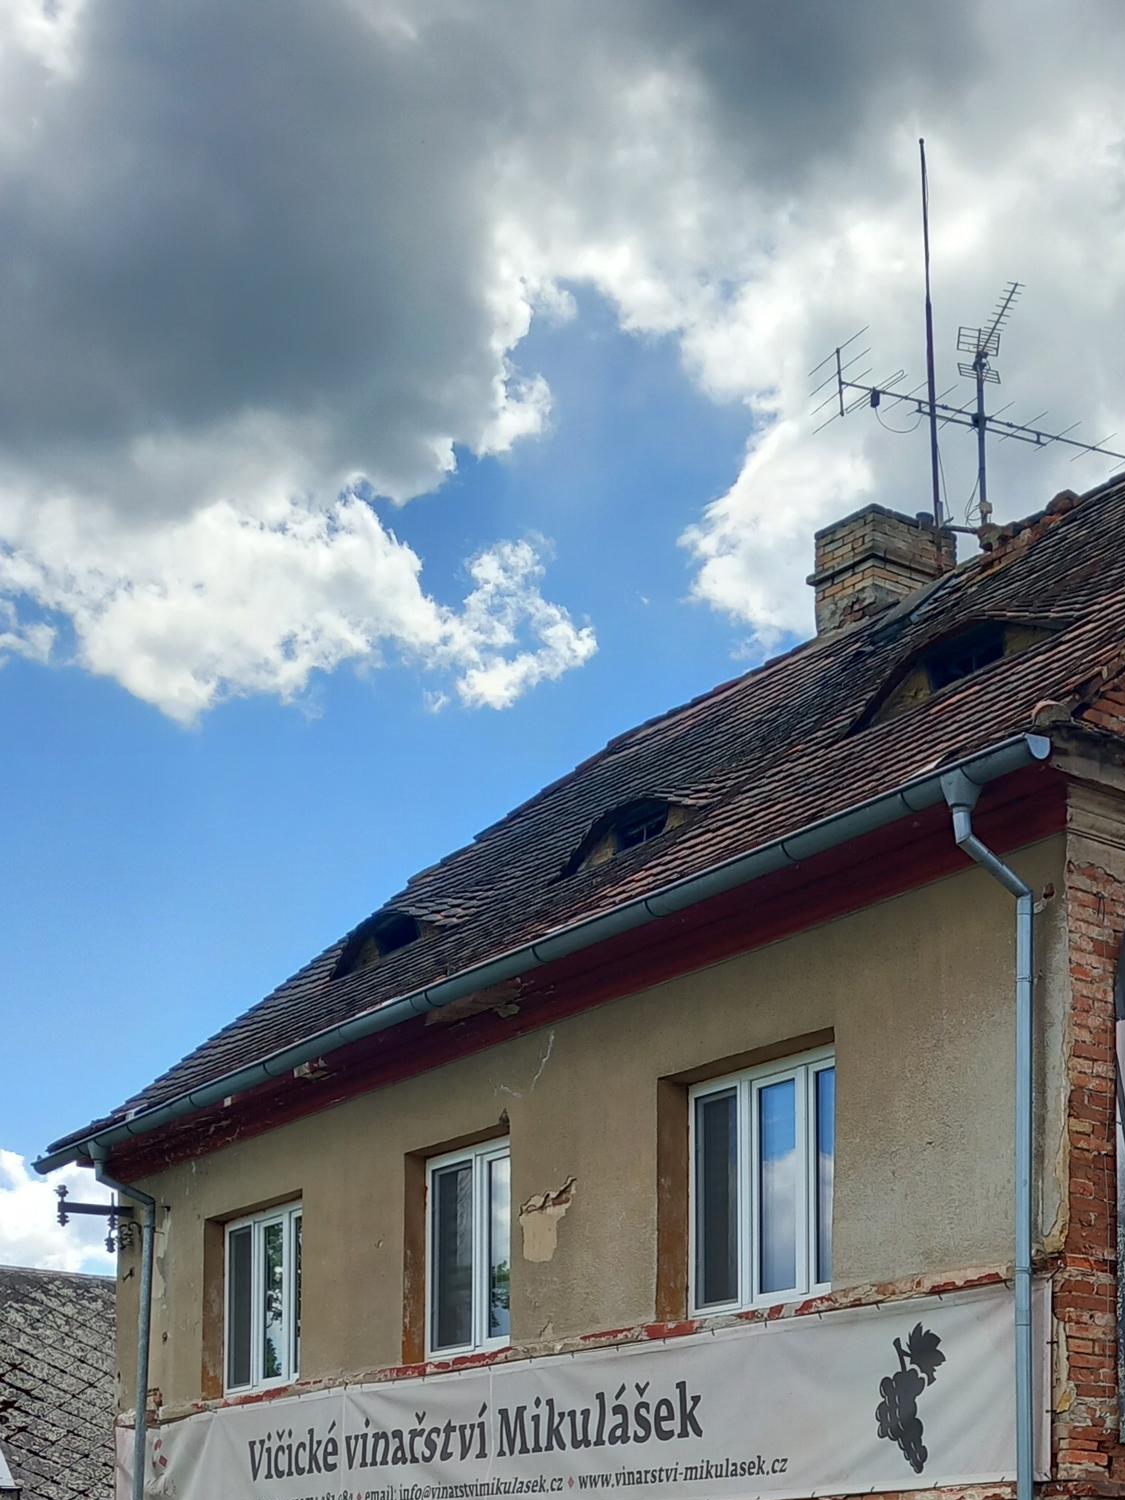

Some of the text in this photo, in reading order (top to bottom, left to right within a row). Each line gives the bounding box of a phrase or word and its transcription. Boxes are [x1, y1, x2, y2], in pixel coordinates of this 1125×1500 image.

[248, 1380, 703, 1482] Vičické vinařství Mikulášek
[578, 1455, 789, 1490] www.vinarstvi-mikulasek.cz
